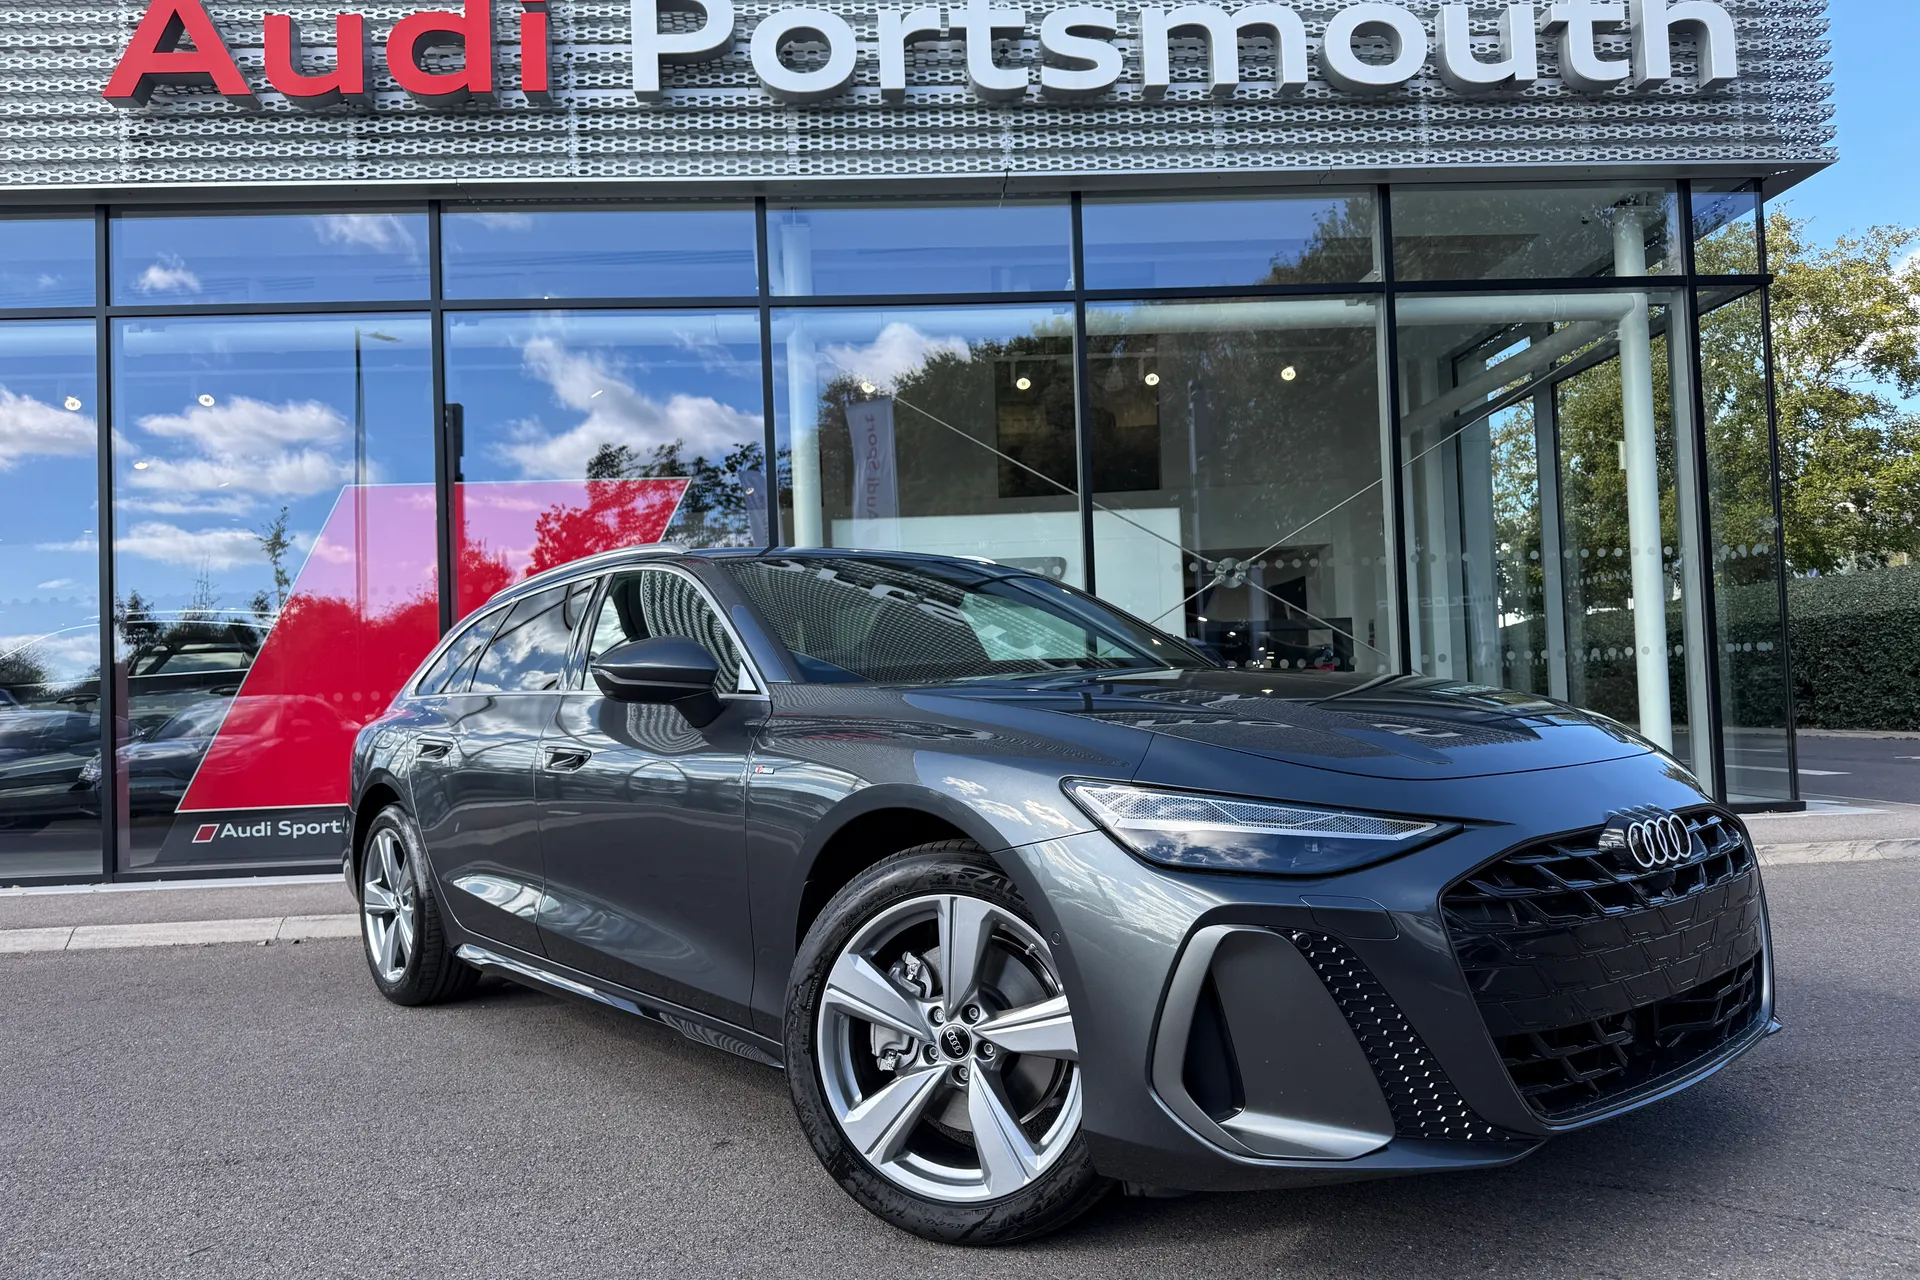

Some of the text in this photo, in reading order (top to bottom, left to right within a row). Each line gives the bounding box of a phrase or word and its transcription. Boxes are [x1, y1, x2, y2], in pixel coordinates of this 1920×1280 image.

[102, 0, 1738, 100] Audi Portsmouth
[220, 819, 342, 839] Audi Sport
